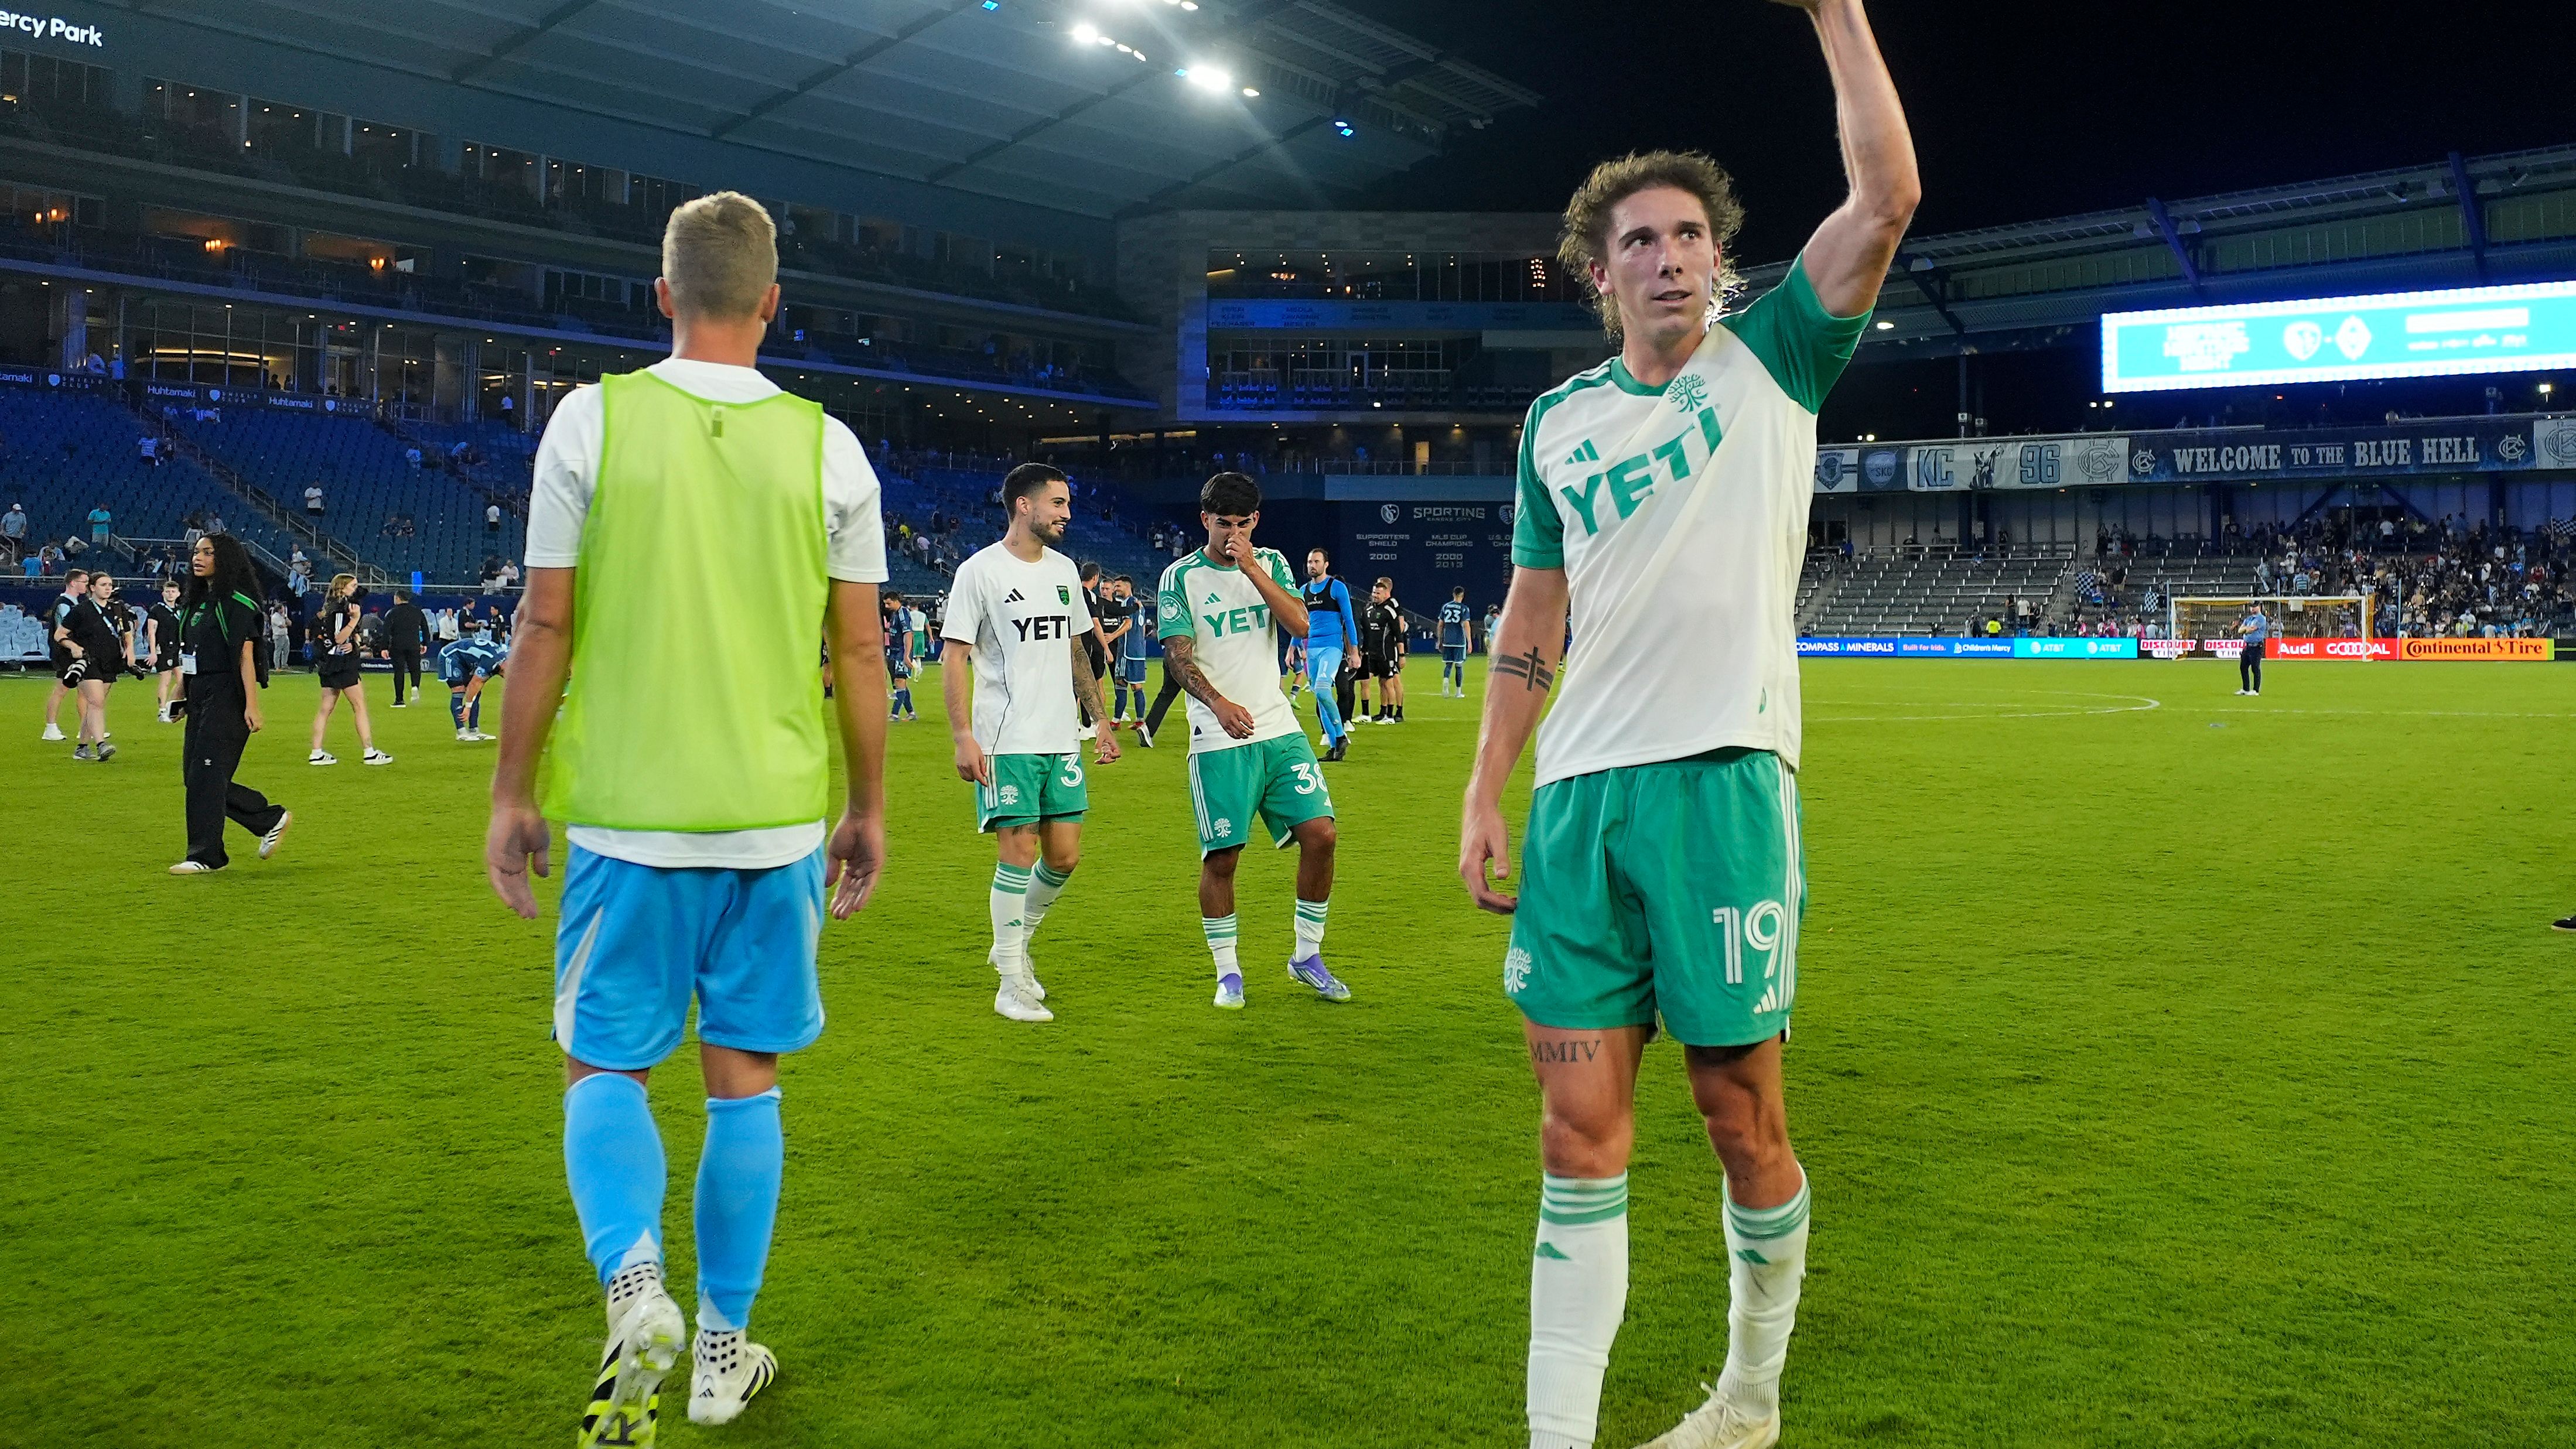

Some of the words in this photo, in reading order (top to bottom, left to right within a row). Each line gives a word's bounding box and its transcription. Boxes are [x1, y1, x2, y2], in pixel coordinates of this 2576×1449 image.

[50, 18, 103, 47] Park
[147, 385, 196, 398] Huhtamaki
[269, 397, 313, 408] Huhtamaki
[2174, 445, 2282, 473] WELCOME
[2291, 448, 2309, 465] TO
[2317, 446, 2343, 464] THE
[2355, 439, 2411, 467] BLUE
[2422, 436, 2479, 464] HELL
[1560, 405, 1723, 536] YETI
[1917, 449, 1955, 487] KC
[2020, 444, 2061, 484] 96
[1413, 507, 1485, 519] SPORTING
[1202, 604, 1270, 637] YET
[1444, 609, 1461, 623] 23
[1796, 642, 1839, 652] COMPASS
[1847, 643, 1894, 652] MINERALS
[1992, 644, 2011, 652] Mercy
[2042, 644, 2065, 652] AT&T
[2099, 644, 2122, 652] AT&T
[2205, 641, 2247, 649] DISCOU
[2278, 643, 2314, 654] Audi
[2407, 641, 2490, 657] Continental
[2505, 641, 2542, 654] Tire
[1323, 661, 1328, 672] 1
[1061, 753, 1082, 787] 3
[1713, 900, 1785, 985] 19
[1531, 1040, 1601, 1063] MMIV
